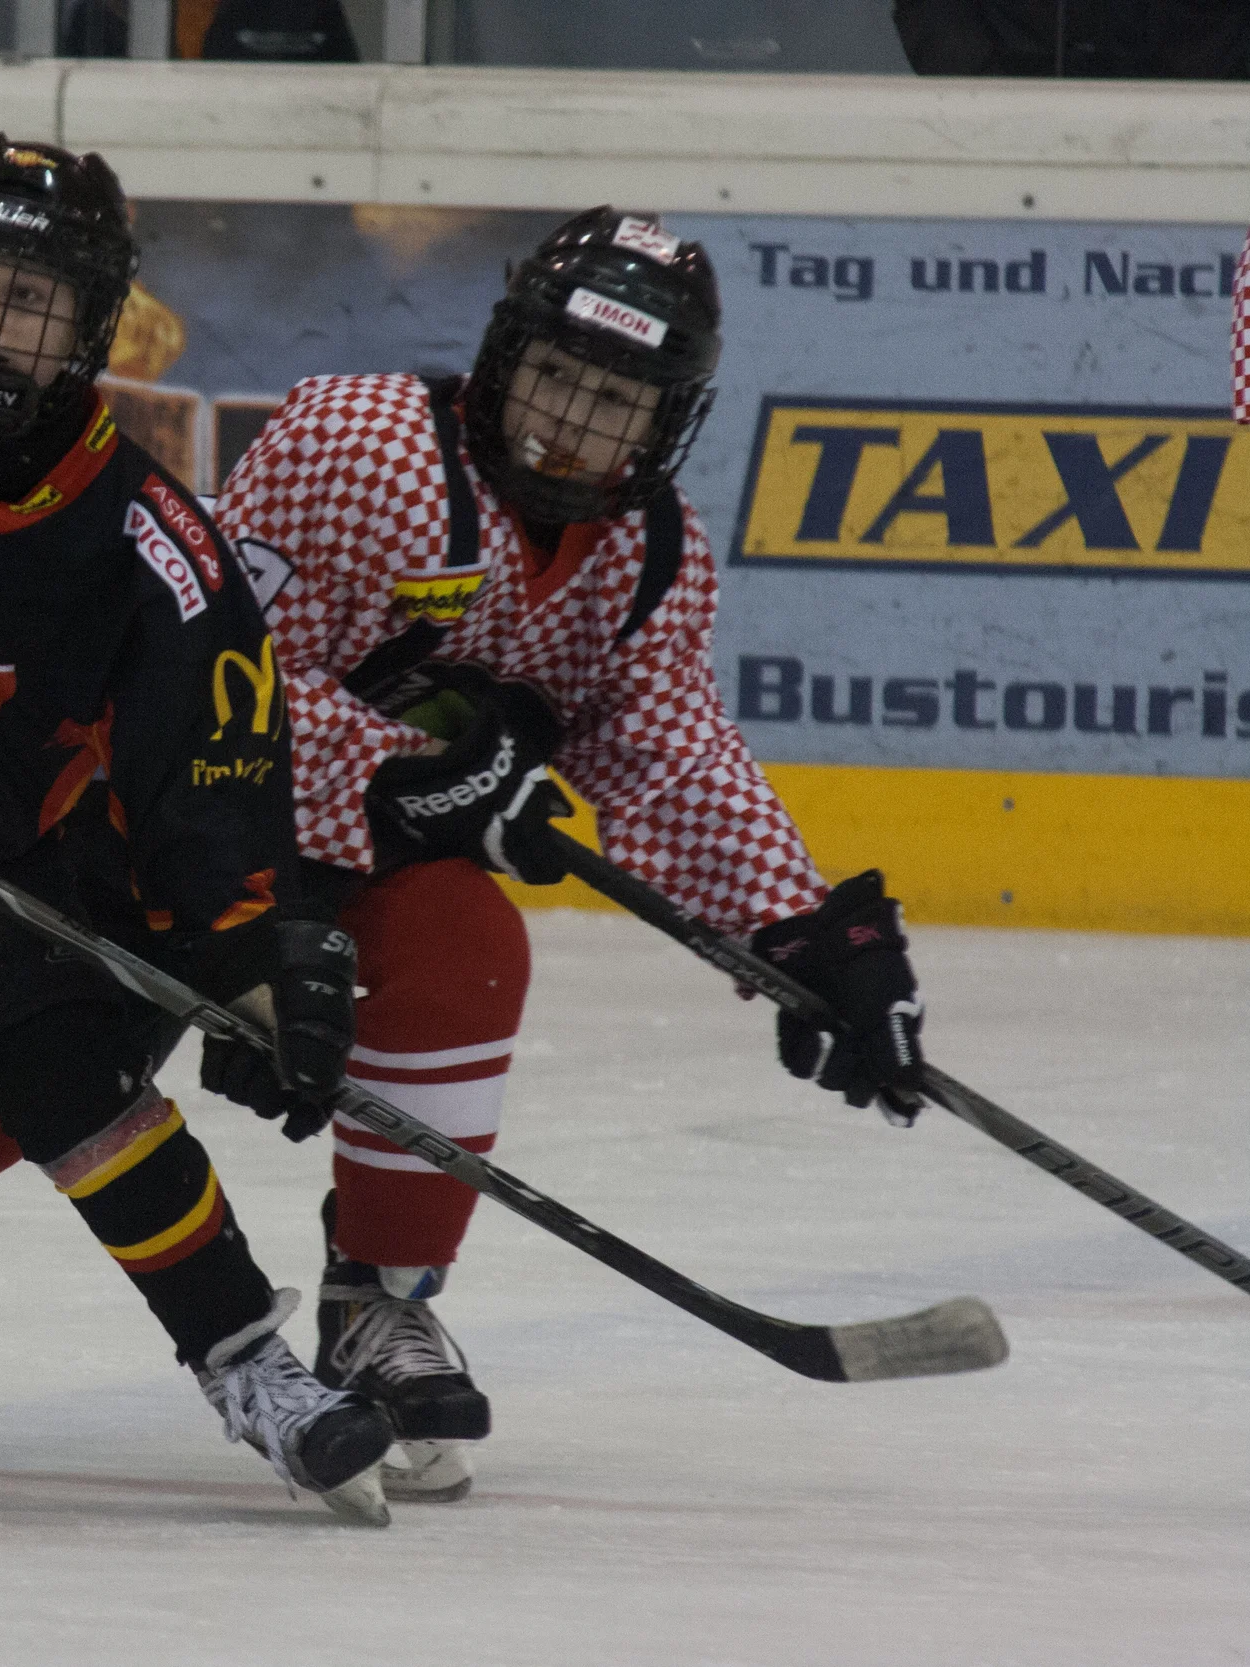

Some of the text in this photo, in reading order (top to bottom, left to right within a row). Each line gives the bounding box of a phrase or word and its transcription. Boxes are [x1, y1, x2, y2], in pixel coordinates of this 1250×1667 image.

[751, 242, 875, 302] Tag
[910, 249, 1047, 294] und
[789, 425, 1234, 553] TAXI
[737, 654, 1250, 740] Bustouri
